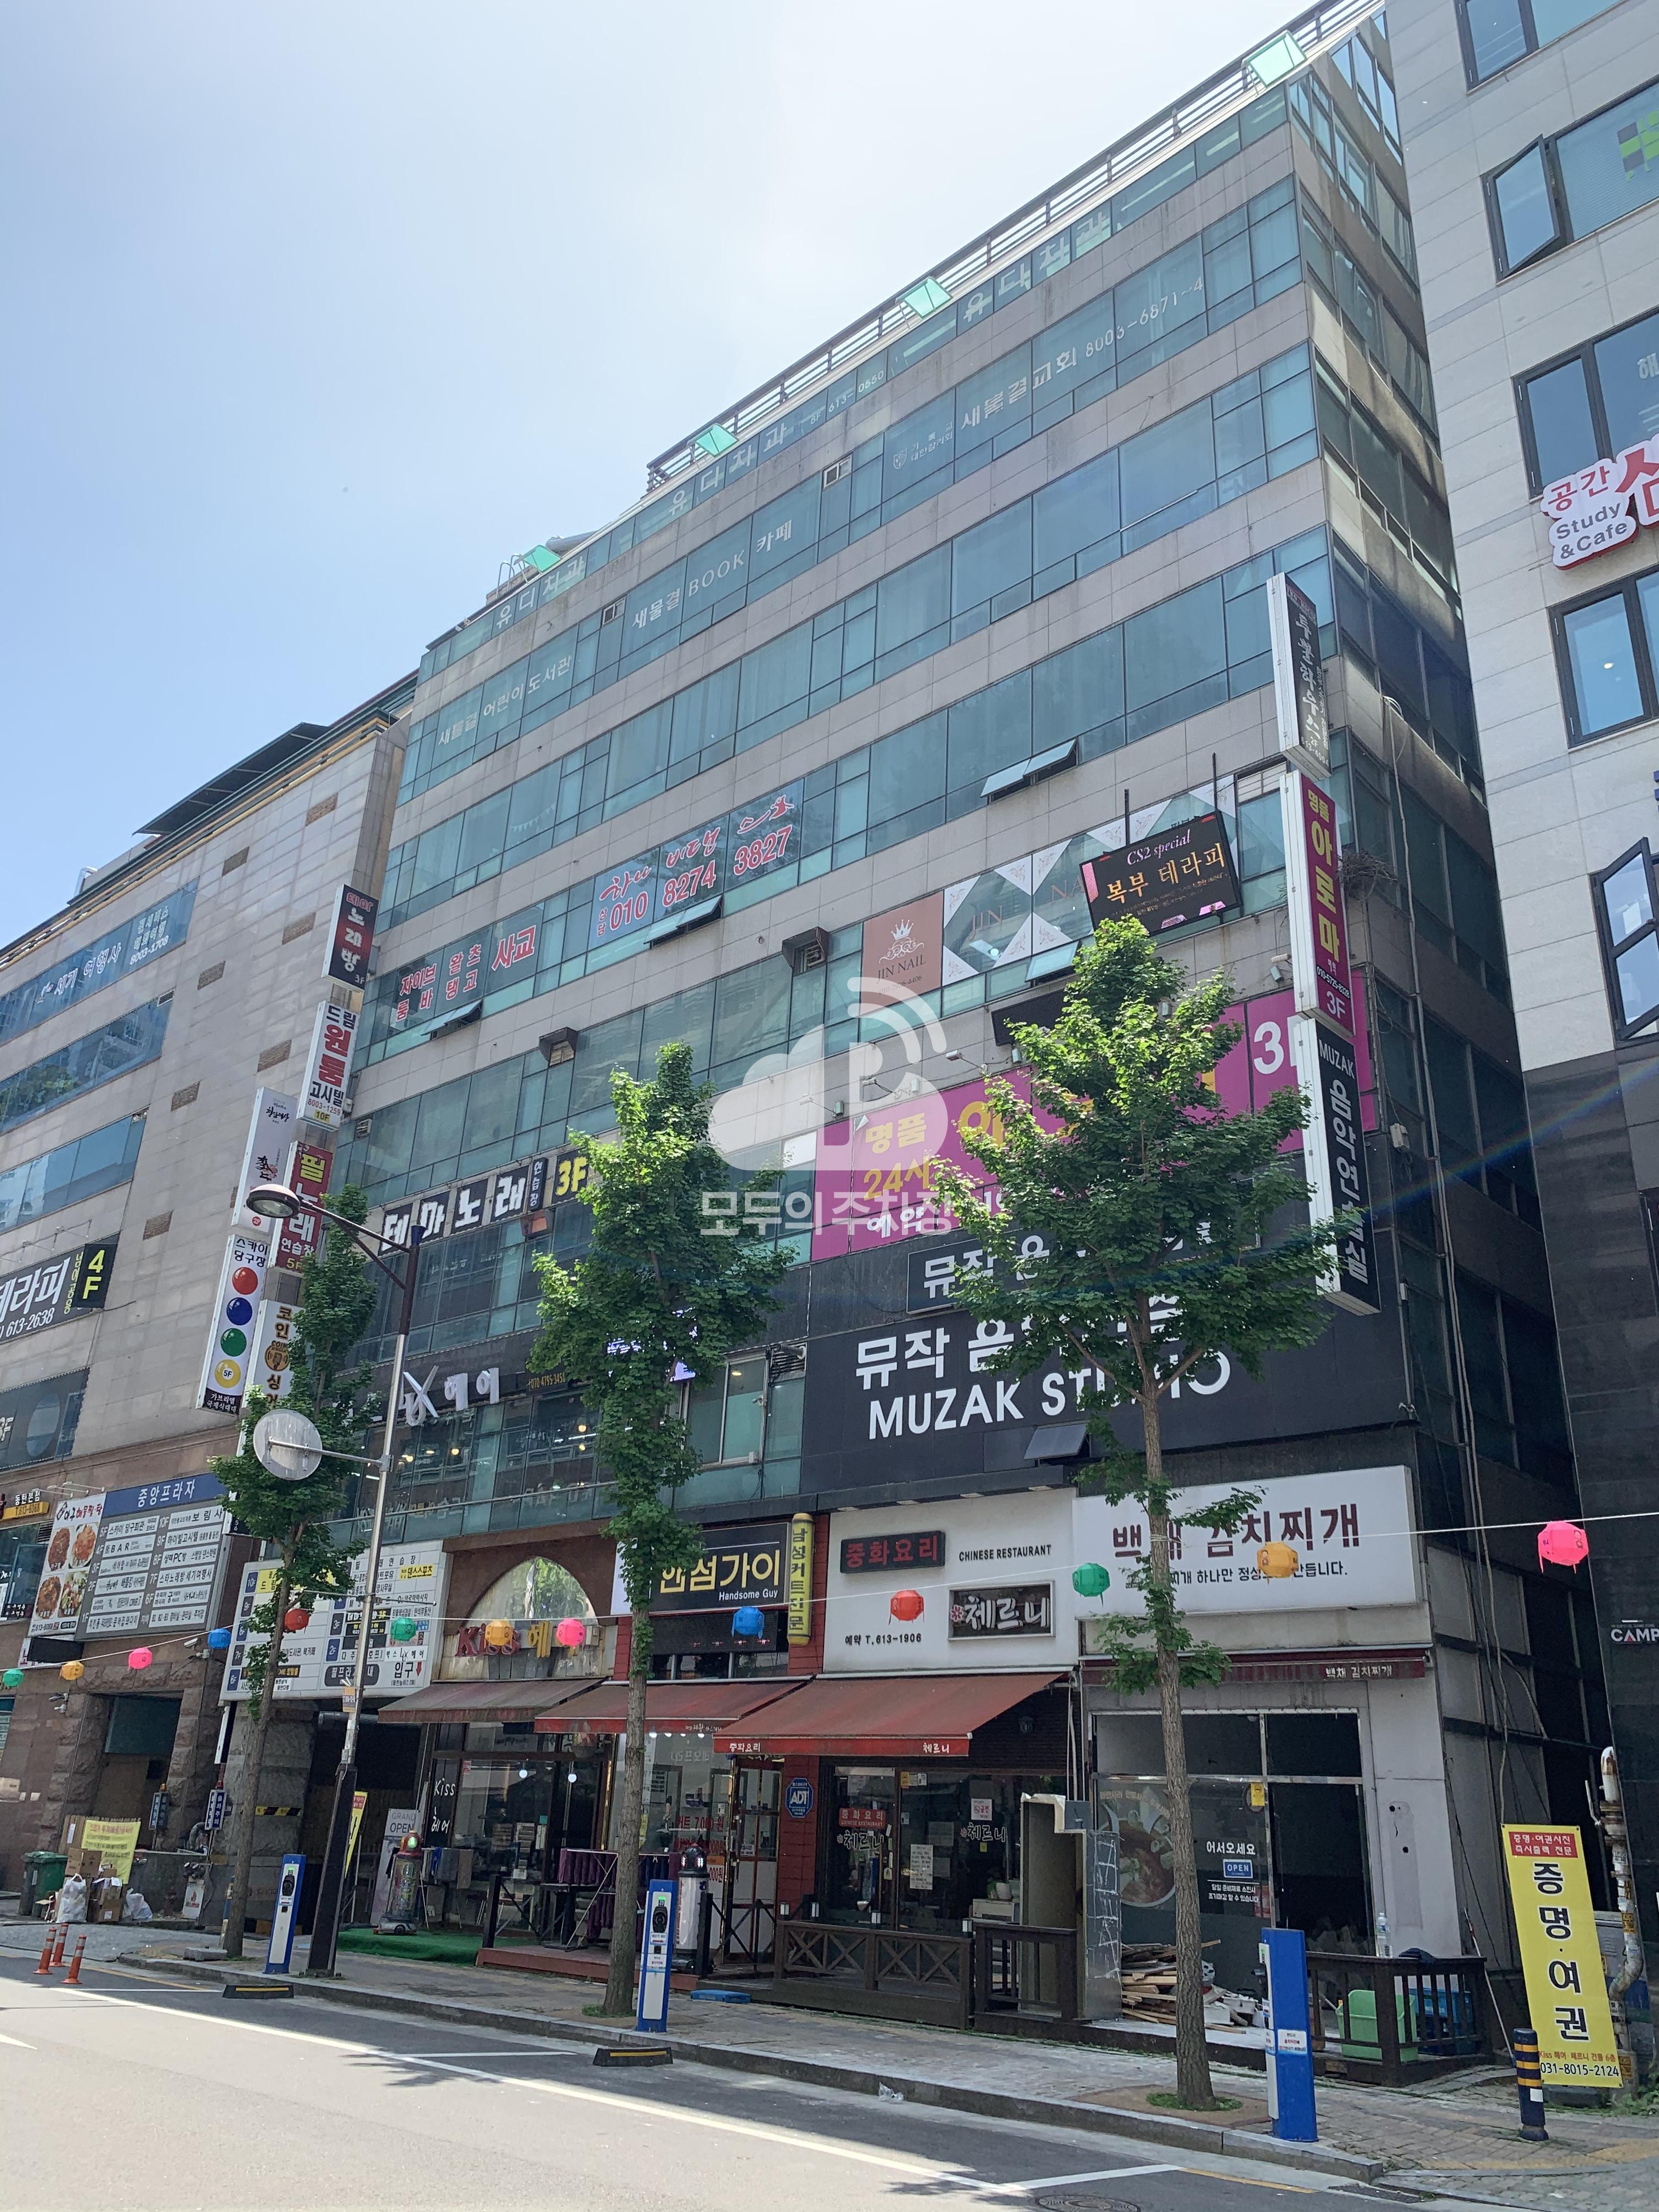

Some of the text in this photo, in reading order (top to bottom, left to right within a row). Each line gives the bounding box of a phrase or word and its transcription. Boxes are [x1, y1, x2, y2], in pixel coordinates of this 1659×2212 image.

[964, 211, 1107, 323] 유디치과
[828, 370, 885, 414] 613-0550
[667, 422, 788, 517] 유디치과
[1548, 465, 1610, 511] 공간
[1556, 502, 1621, 539] Study
[1560, 521, 1628, 560] &Cafe
[632, 519, 794, 630] 새물결 BOOK 카페
[1308, 789, 1329, 823] 명품
[1127, 829, 1191, 865] CS2 special
[609, 890, 649, 932] 010
[661, 860, 718, 908] 8274
[733, 825, 793, 876] 3827
[1107, 872, 1149, 904] 복부
[1158, 843, 1225, 885] 테라피
[1311, 820, 1340, 962] 아로마
[346, 893, 373, 913] 테마
[341, 907, 365, 973] 노래방
[492, 924, 537, 972] 사교
[83, 942, 122, 978] 여행사
[400, 944, 482, 996] 자이브 왈츠
[876, 955, 926, 984] JIN NAIL
[1327, 990, 1346, 1019] 3F
[326, 1005, 357, 1030] 드림
[318, 1024, 351, 1087] 원룸
[1319, 1038, 1355, 1079] MUZAK
[309, 1081, 344, 1108] 고시텔
[316, 1110, 330, 1121] 10F
[865, 1112, 927, 1154] 명품
[555, 1156, 588, 1197] 3F
[862, 1158, 933, 1201] 24시
[1329, 1079, 1368, 1285] 음악연실
[866, 1206, 924, 1239] 예약
[236, 1238, 268, 1255] 스카이
[281, 1236, 315, 1257] 연습장
[234, 1249, 266, 1268] 당구장
[286, 1257, 303, 1269] 5F
[6, 1307, 55, 1338] 613-2638
[275, 1306, 292, 1339] 코인
[856, 1328, 950, 1391] 뮤작
[869, 1349, 1231, 1440] MUZAK STIO
[15, 1491, 41, 1505] 동탄본점
[138, 1479, 195, 1508] 중앙프라자
[100, 1527, 108, 1537] 5F
[1207, 1503, 1359, 1559] 김치찌개
[95, 1545, 104, 1555] 4F
[157, 1536, 165, 1547] 9F
[846, 1535, 1052, 1568] 중화요리 CHINESE RESTAURANT
[92, 1563, 100, 1573] 3F
[153, 1554, 162, 1565] 8F
[150, 1573, 158, 1584] 7F
[1197, 1567, 1234, 1584] 하나만
[88, 1581, 97, 1592] 2F
[719, 1589, 778, 1601] Handsome Guy
[145, 1593, 154, 1605] 6F
[244, 1602, 251, 1611] 9F
[82, 1612, 89, 1623] 1F
[964, 1596, 1050, 1630] 체르니
[333, 1620, 341, 1629] 3F
[845, 1633, 921, 1646] 예약 T.613-1906
[1610, 1628, 1659, 1642] CAMP
[235, 1652, 241, 1660] 7F
[330, 1645, 336, 1655] 2F
[230, 1676, 237, 1684] 6F
[394, 1662, 413, 1678] 입구
[1350, 1664, 1392, 1679] 김치찌개
[729, 1742, 761, 1753] 중화요리
[923, 1742, 950, 1754] 체르니
[434, 1778, 456, 1797] Kiss
[790, 1790, 809, 1804] ADT
[391, 1812, 416, 1821] GRAND
[390, 1822, 415, 1833] OPEN
[967, 1822, 1007, 1842] 체르니
[844, 1830, 884, 1851] 체르니
[1206, 1841, 1256, 1855] 어서오세요
[1555, 1846, 1572, 1855] 전문
[1538, 2051, 1552, 2059] Kiss
[1540, 2062, 1619, 2076] 031-8015-2124
